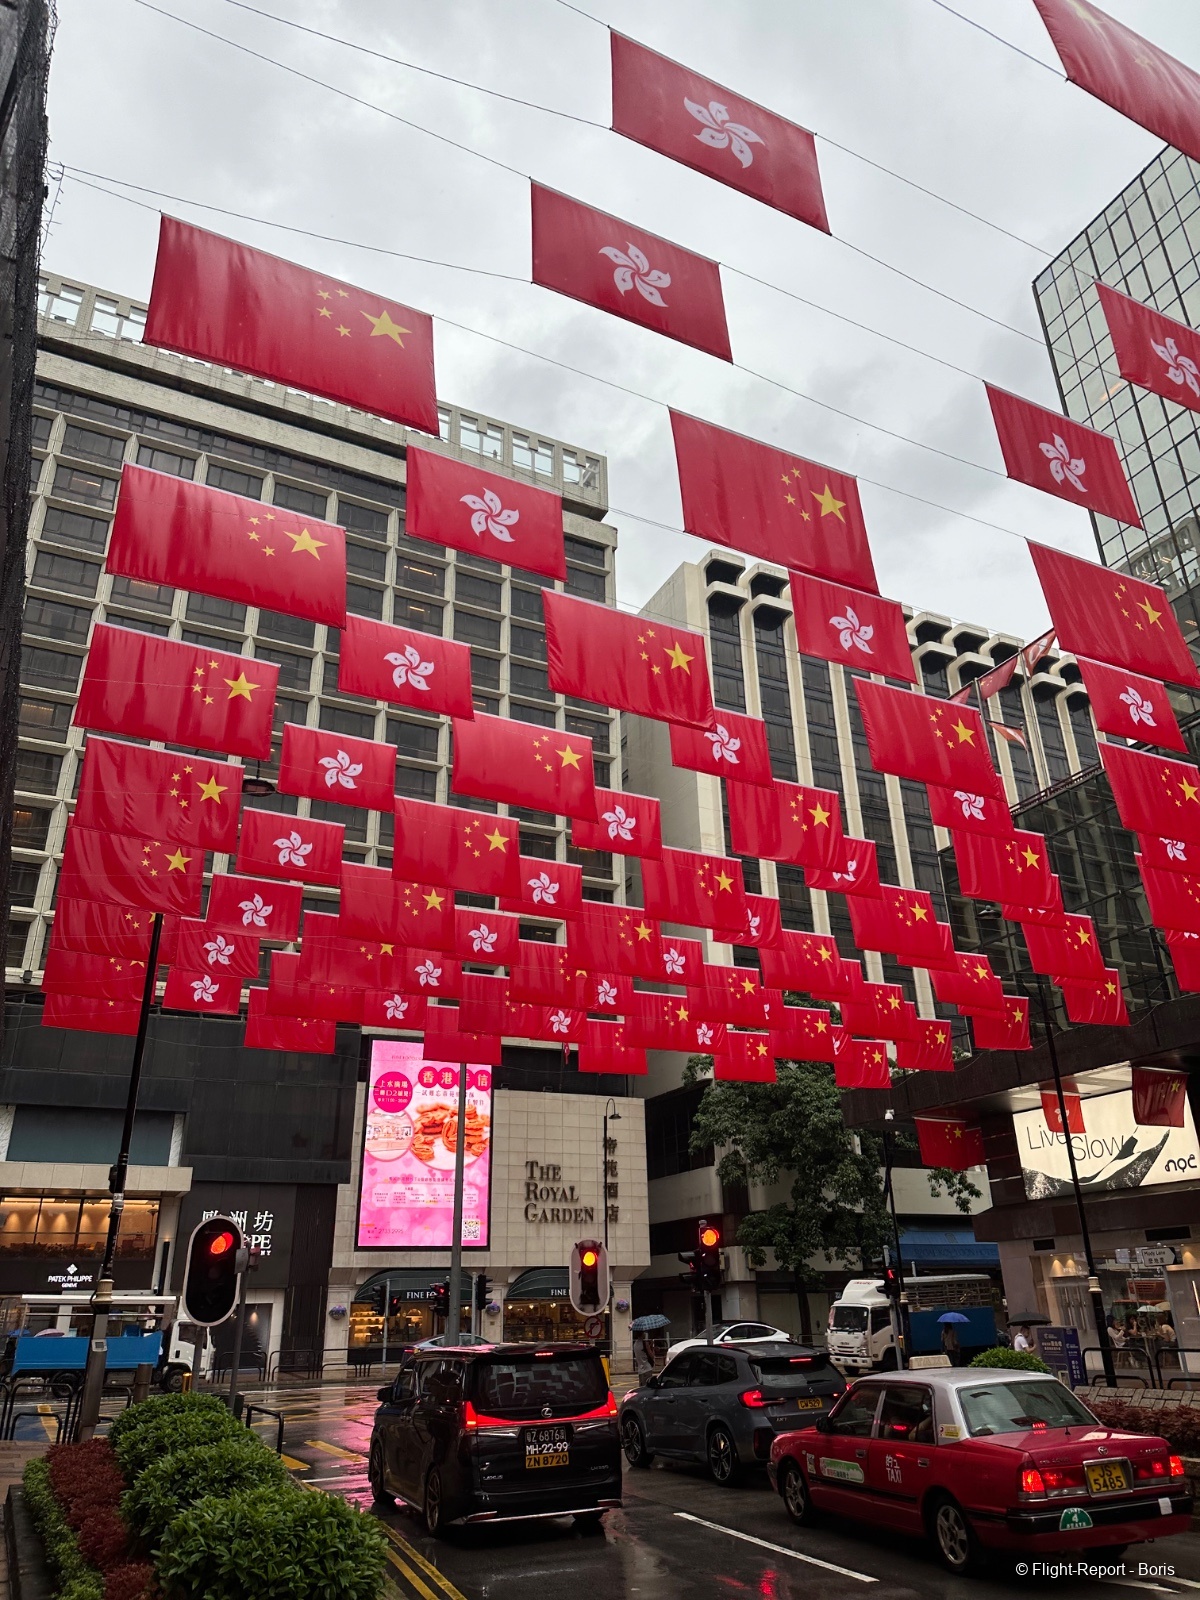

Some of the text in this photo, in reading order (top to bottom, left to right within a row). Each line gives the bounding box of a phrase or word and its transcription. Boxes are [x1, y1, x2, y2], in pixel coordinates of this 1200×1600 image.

[1026, 1124, 1067, 1150] Live
[525, 1160, 561, 1181] THE
[525, 1181, 580, 1202] ROYAL
[524, 1202, 594, 1223] GARDEN
[406, 1291, 425, 1299] FINE
[550, 1288, 567, 1296] FINE
[526, 1441, 568, 1455] MH-22-99
[527, 1453, 568, 1467] ZN 8720
[886, 1467, 902, 1483] TAXI
[1099, 1464, 1113, 1478] JS
[1093, 1477, 1124, 1491] 5485
[1071, 1513, 1079, 1523] 4
